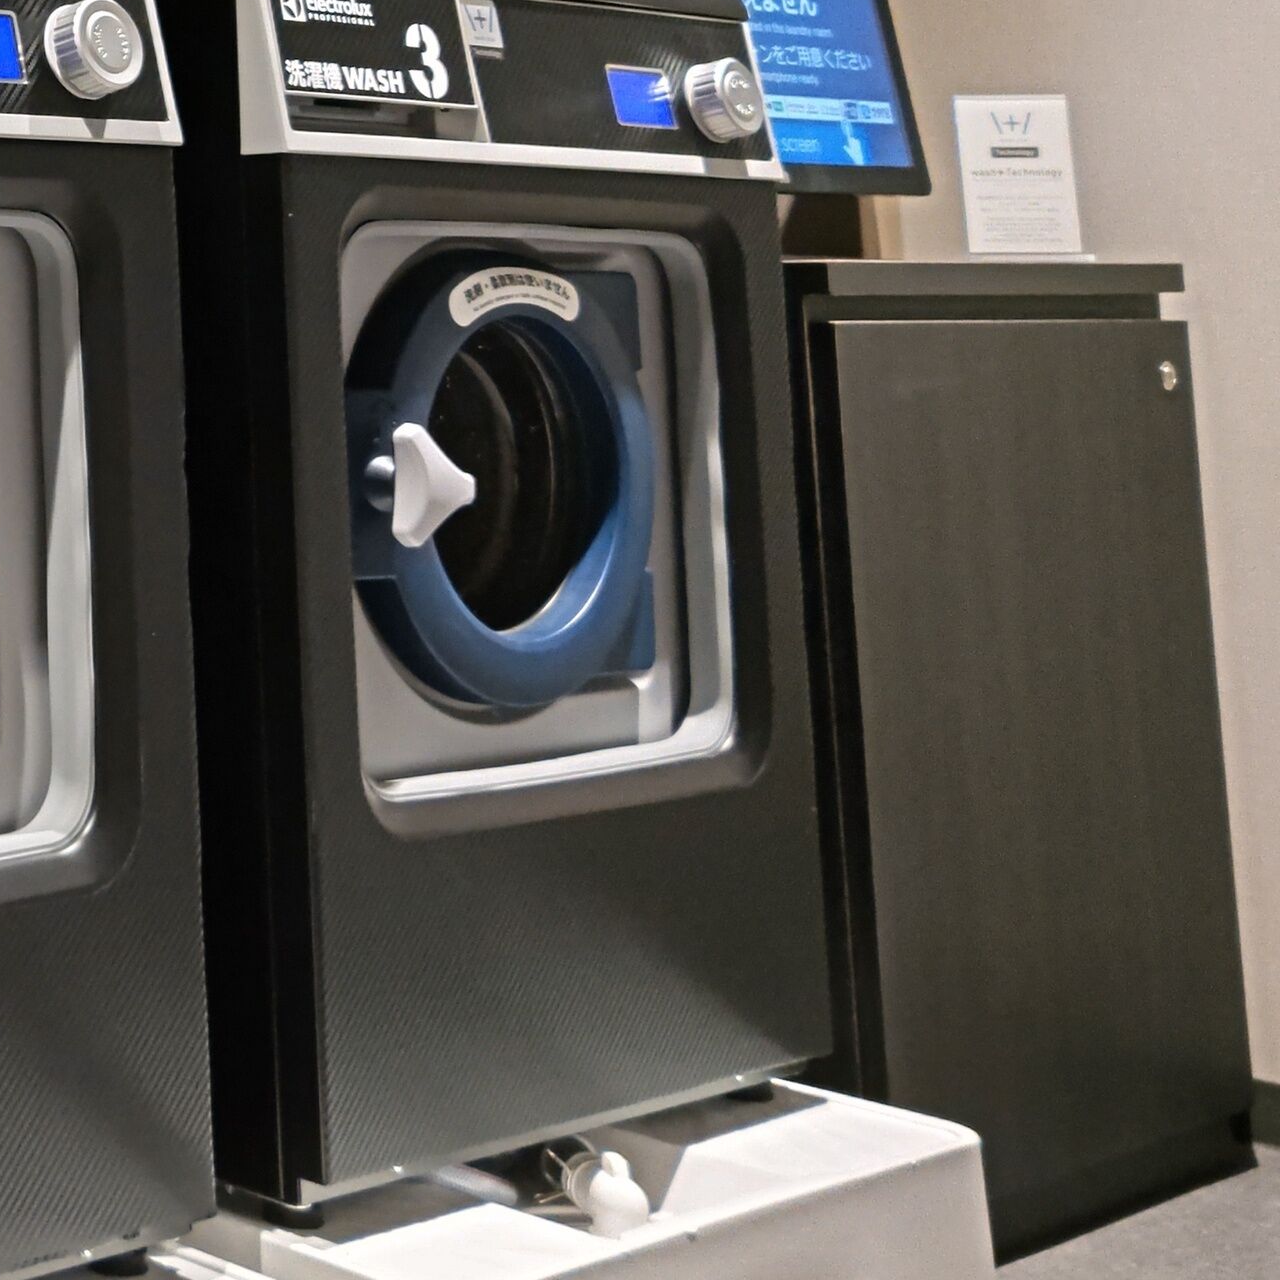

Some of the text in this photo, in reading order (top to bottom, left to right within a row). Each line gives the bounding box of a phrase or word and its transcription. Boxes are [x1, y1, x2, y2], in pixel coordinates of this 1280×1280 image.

[285, 23, 449, 99] 洗濯機 WASH 3
